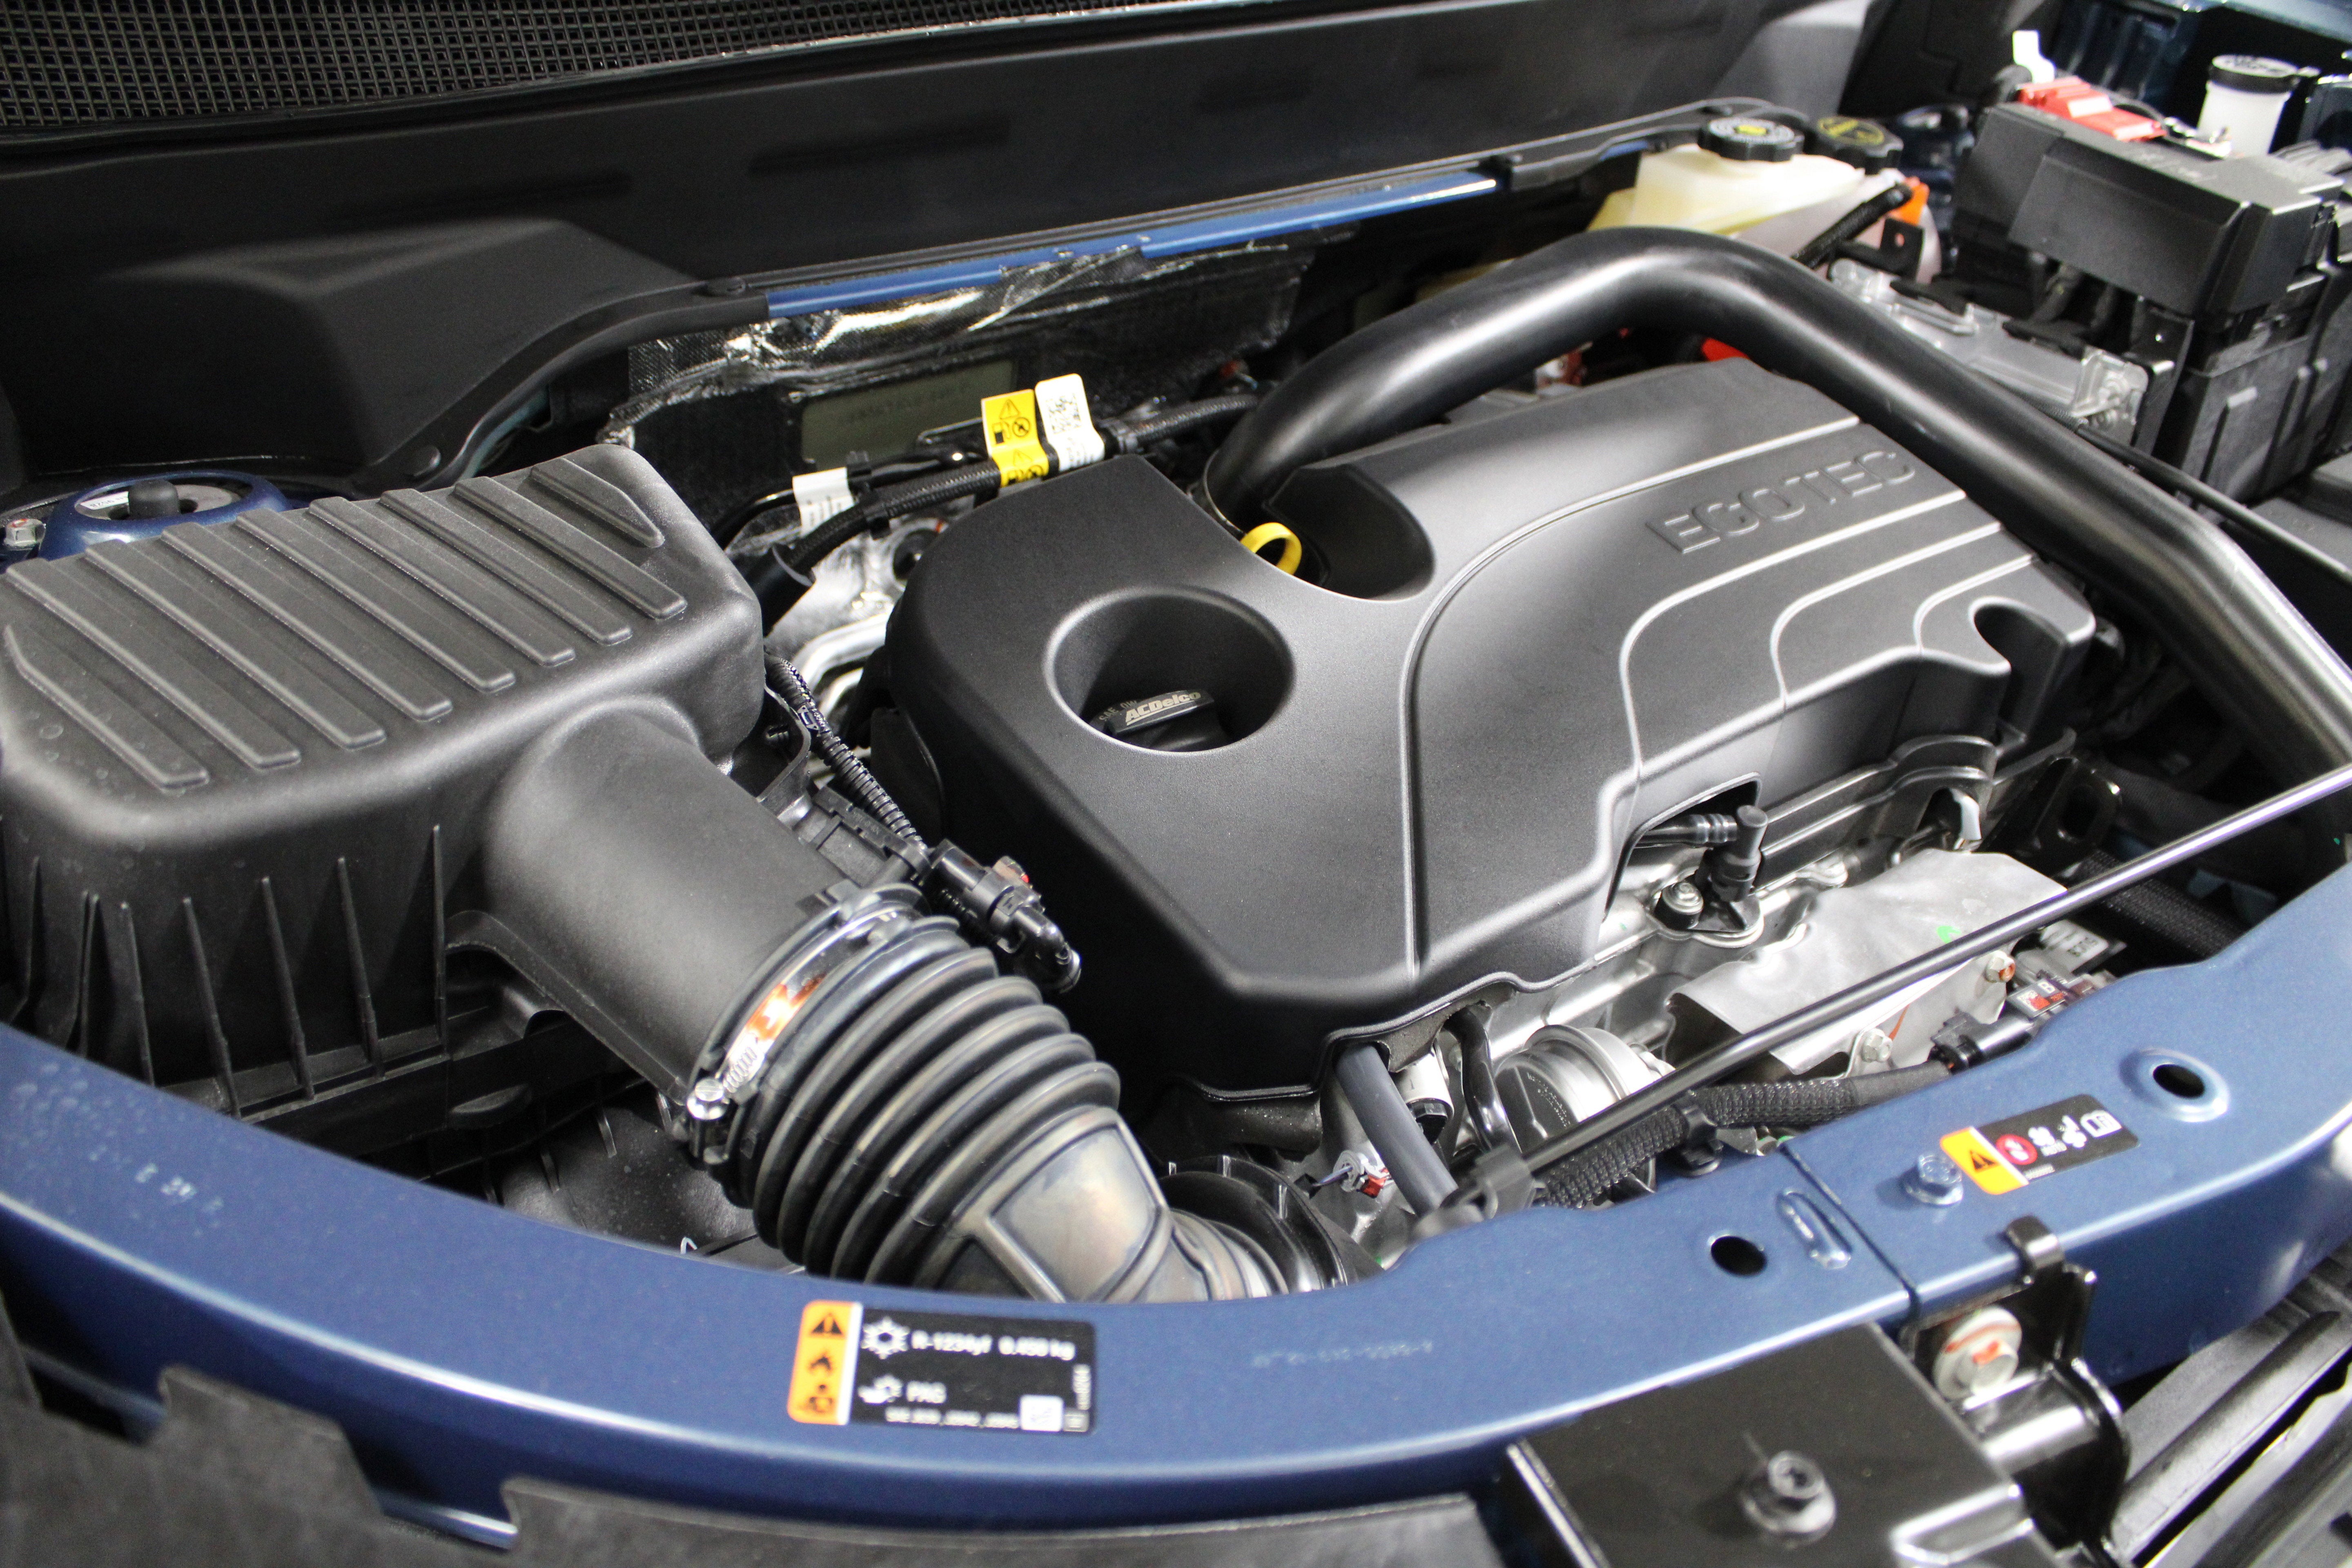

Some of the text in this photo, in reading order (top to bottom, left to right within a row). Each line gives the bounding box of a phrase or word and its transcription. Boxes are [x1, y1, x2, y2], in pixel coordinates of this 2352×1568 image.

[1646, 450, 1915, 554] ECOTEC
[1099, 707, 1119, 722] SAE
[1125, 692, 1201, 723] ACDelco
[1049, 1338, 1076, 1361] kg
